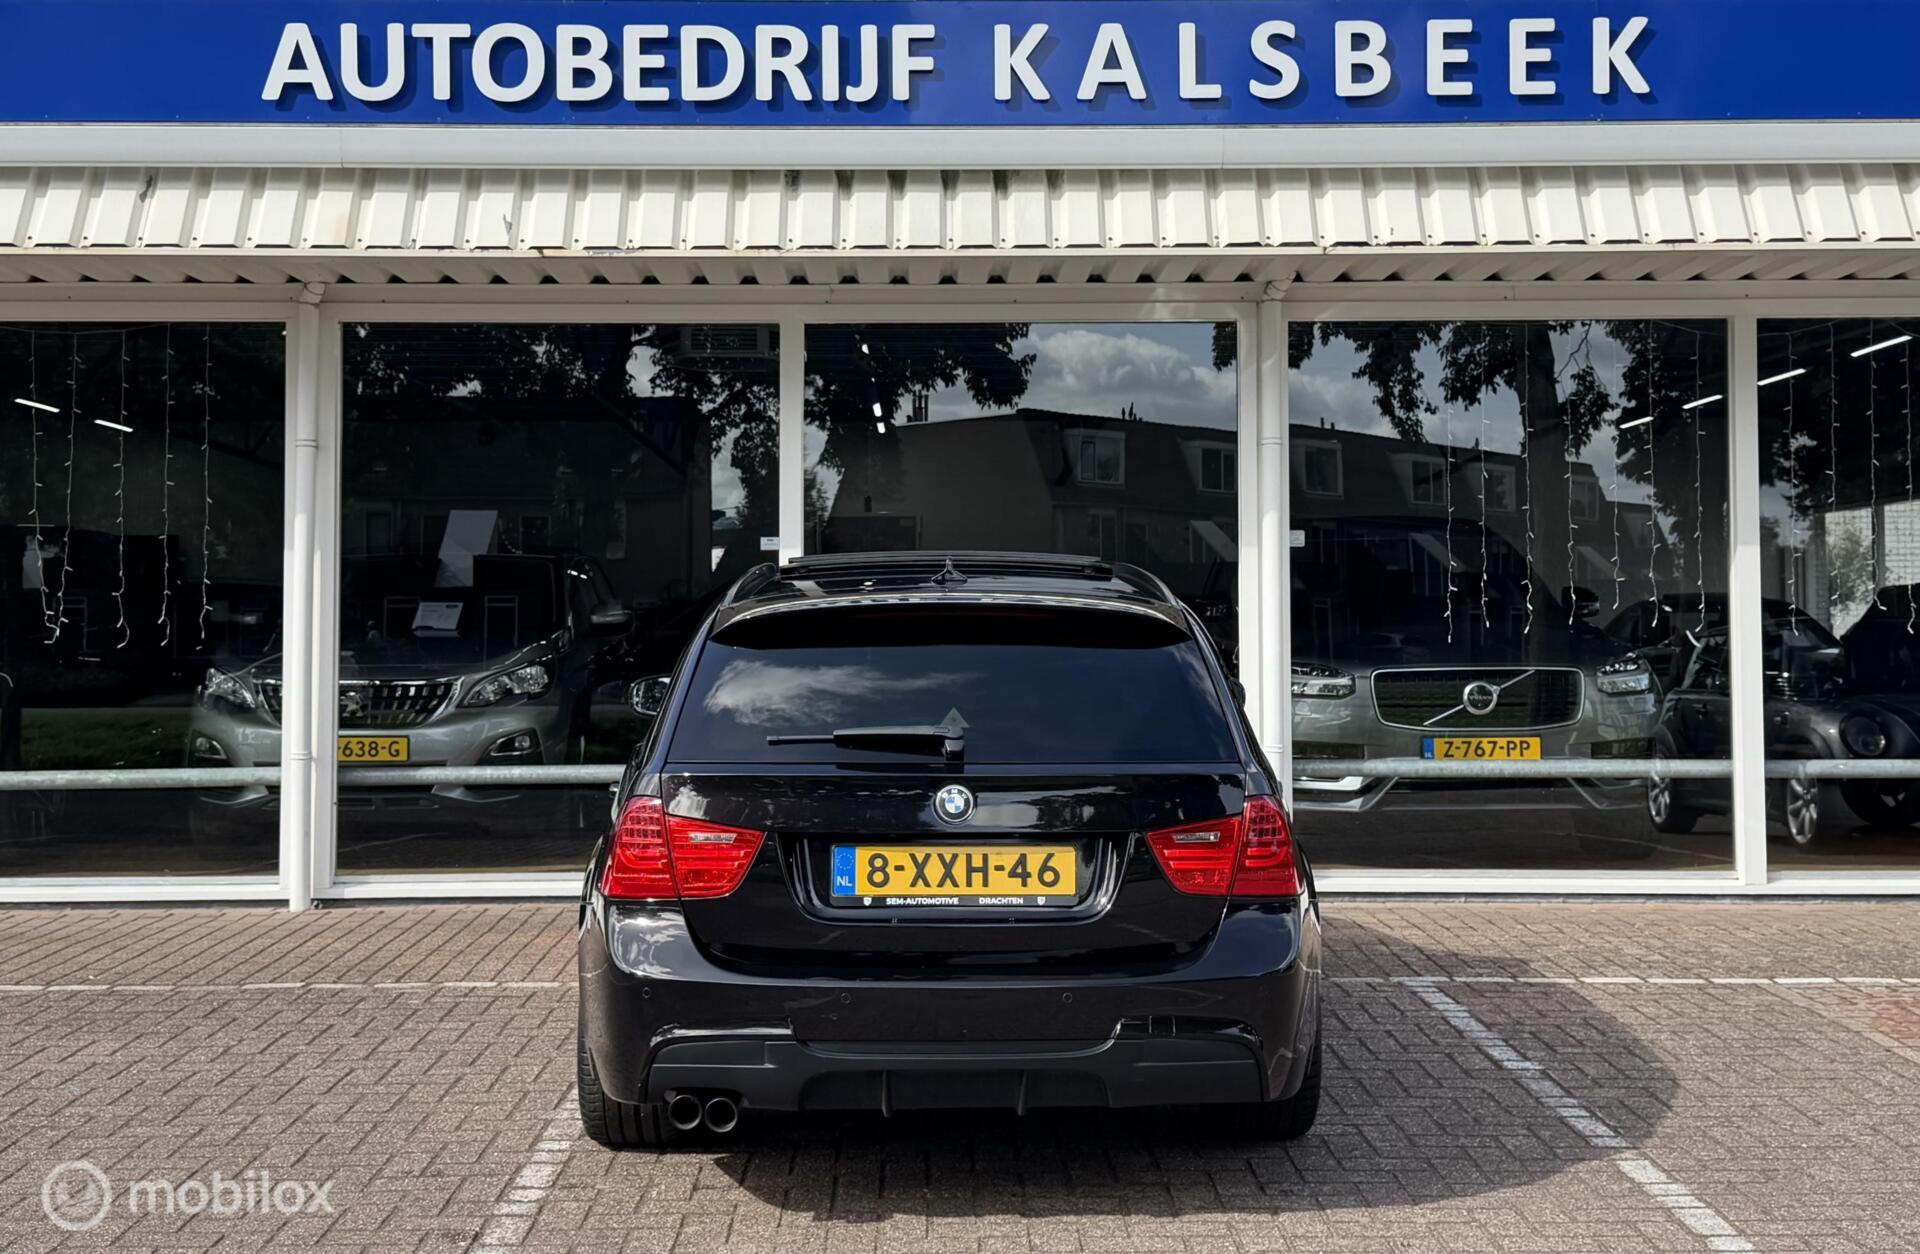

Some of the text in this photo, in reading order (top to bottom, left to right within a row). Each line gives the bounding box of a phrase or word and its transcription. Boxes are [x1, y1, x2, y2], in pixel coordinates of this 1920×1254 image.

[261, 16, 1651, 102] AUTOBEDRIJF KALSBEEK
[1443, 740, 1530, 758] Z-767-PP
[866, 852, 1061, 888] 8-XXH-46
[836, 875, 852, 887] NL
[886, 896, 1024, 905] SEM-AUTOMOTIVE DRACHTEN
